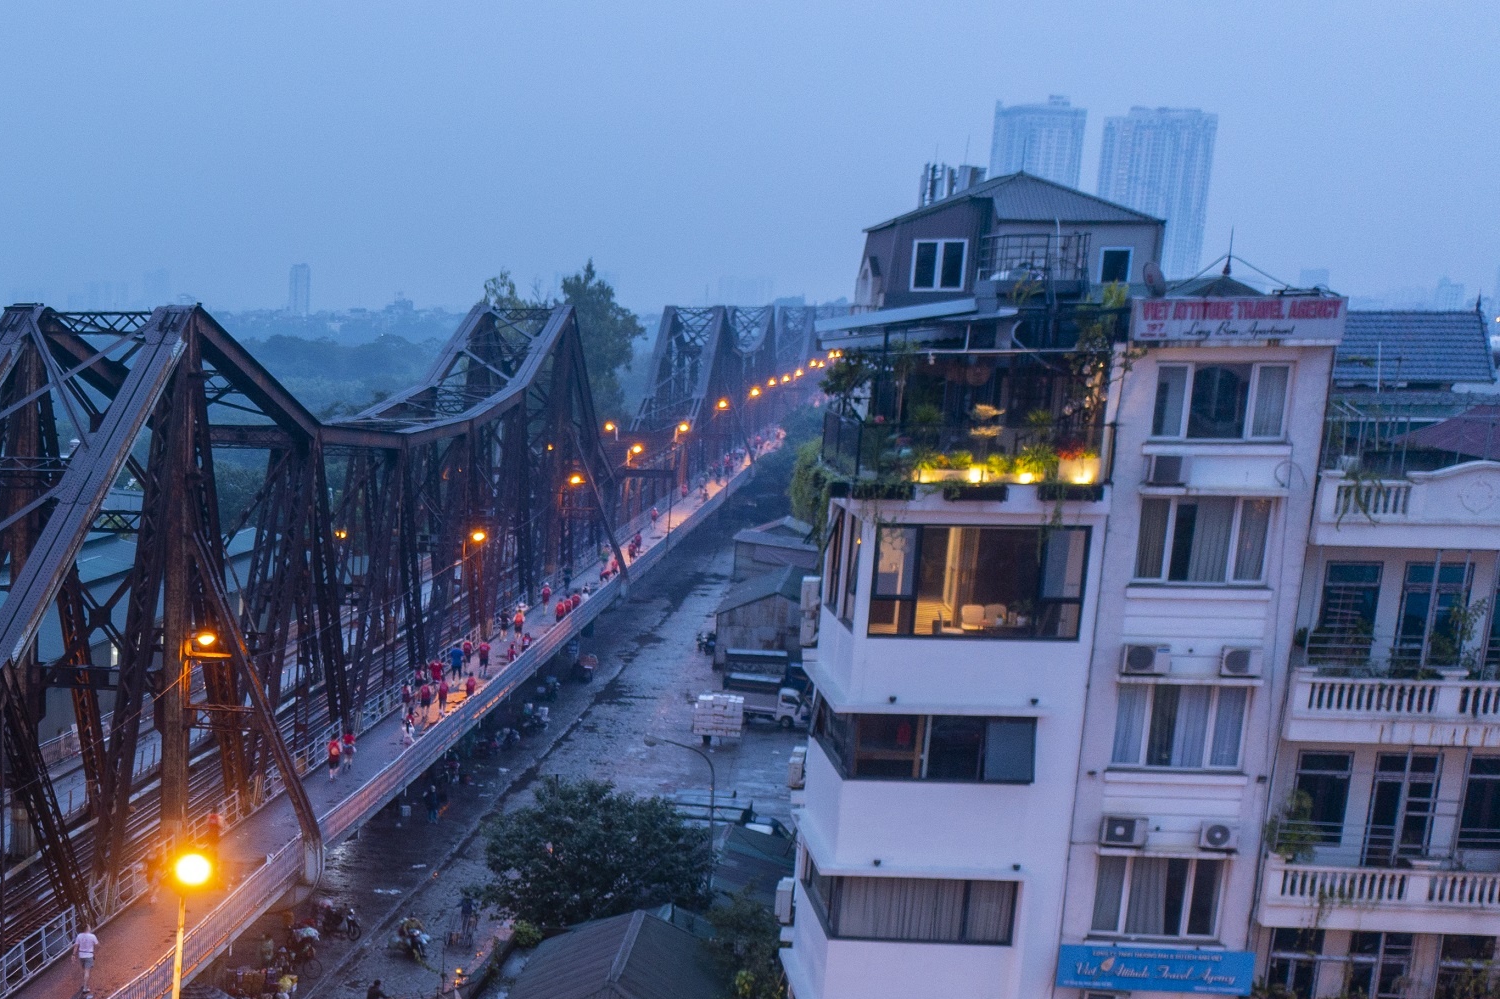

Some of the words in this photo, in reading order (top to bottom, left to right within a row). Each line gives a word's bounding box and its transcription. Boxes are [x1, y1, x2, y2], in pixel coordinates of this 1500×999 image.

[1173, 302, 1234, 320] ATTITUDE
[1238, 301, 1285, 320] TRAVEL
[1288, 300, 1343, 319] AGENCY
[1154, 965, 1194, 980] Travel
[1197, 967, 1236, 985] Agency
